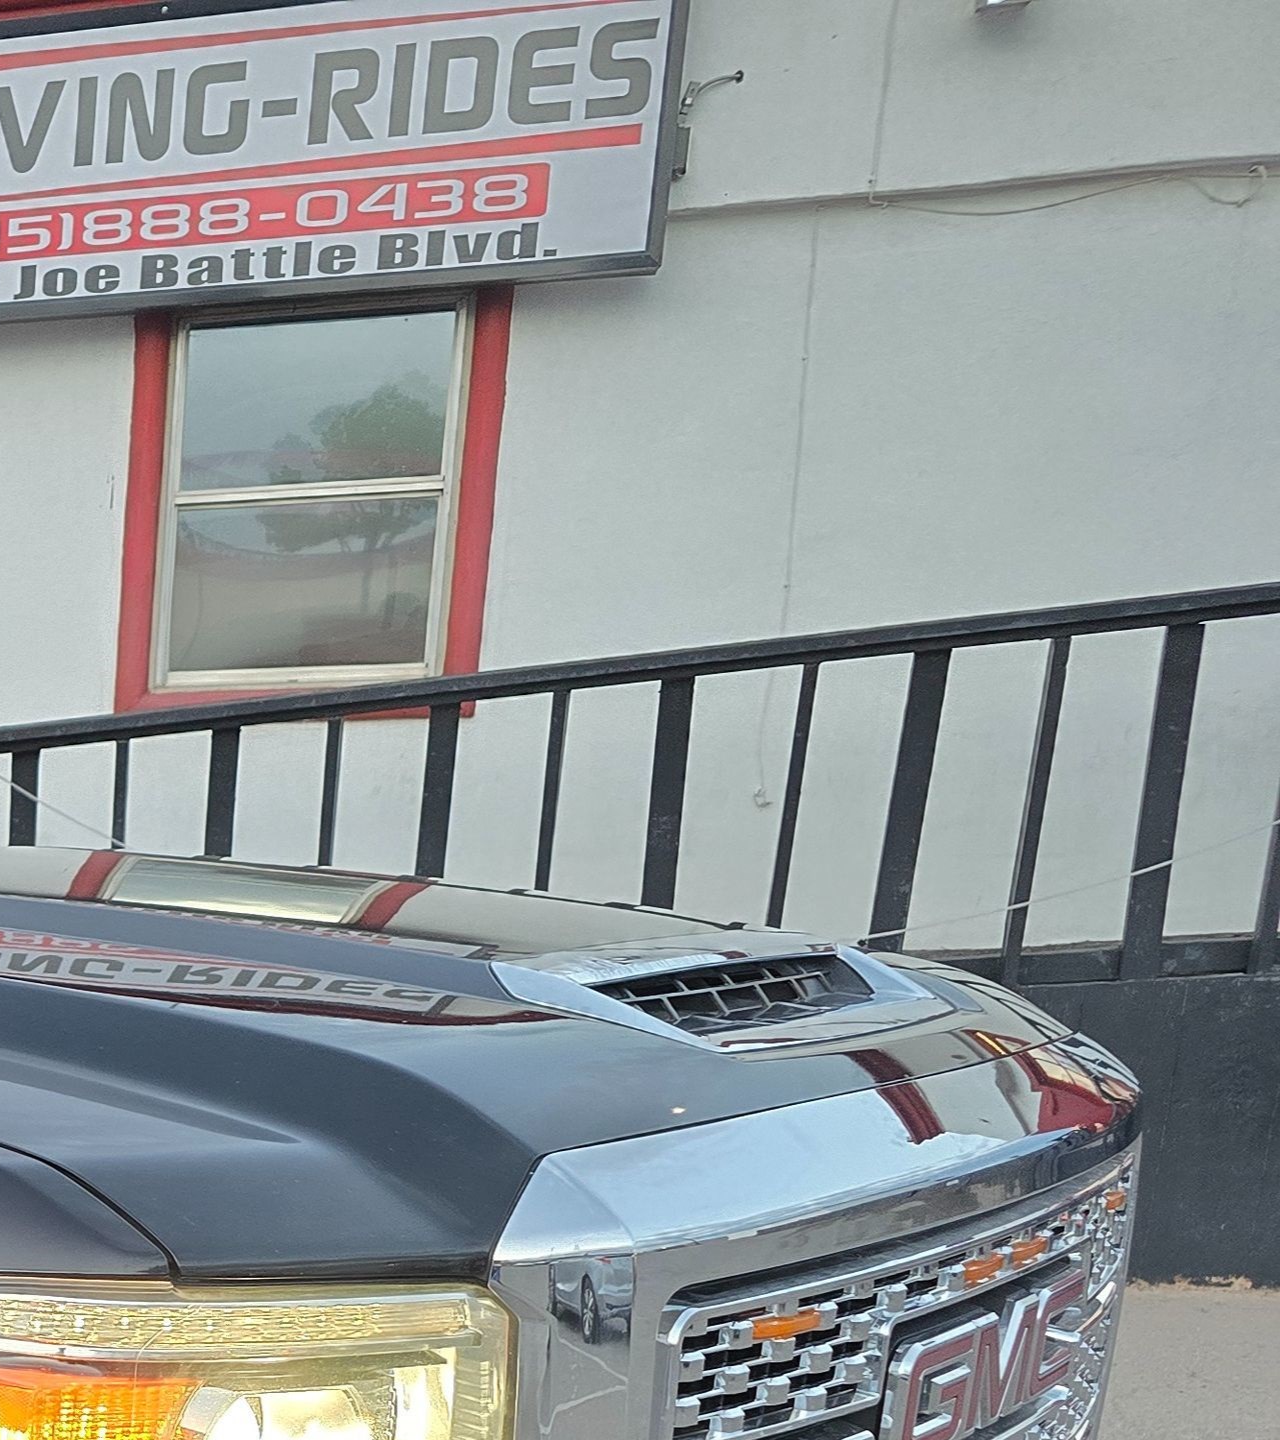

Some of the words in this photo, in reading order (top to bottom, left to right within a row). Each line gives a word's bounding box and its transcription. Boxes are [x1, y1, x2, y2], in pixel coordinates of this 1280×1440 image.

[13, 264, 121, 300] Joe
[139, 240, 357, 290] Battle
[376, 222, 558, 271] Blvd.
